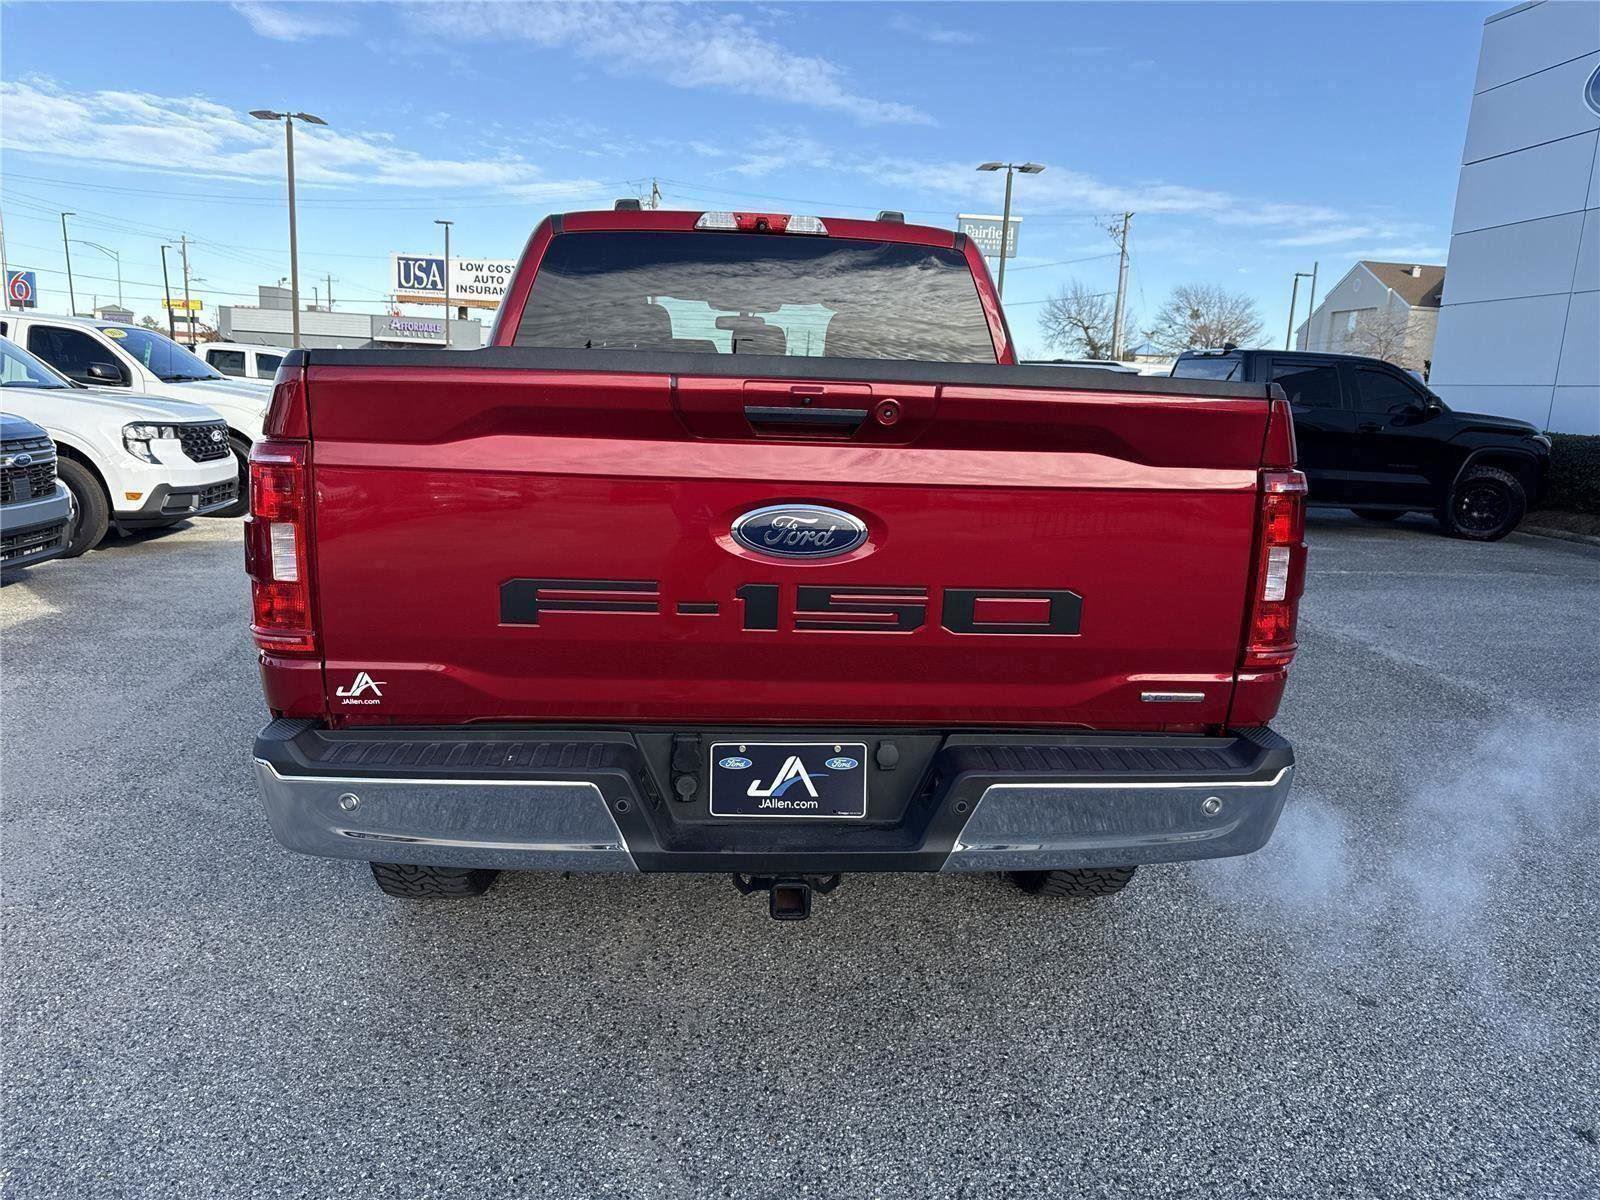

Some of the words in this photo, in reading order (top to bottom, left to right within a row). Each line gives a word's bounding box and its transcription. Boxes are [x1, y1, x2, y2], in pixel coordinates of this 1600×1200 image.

[965, 224, 1014, 239] Fairfied
[398, 260, 443, 289] USA
[460, 262, 484, 273] LOW
[10, 271, 31, 301] 6
[473, 275, 504, 285] AUTO
[456, 284, 506, 296] INSURAN
[763, 515, 836, 546] Ford
[498, 578, 1083, 637] F-150
[758, 799, 818, 809] JAllen.com
